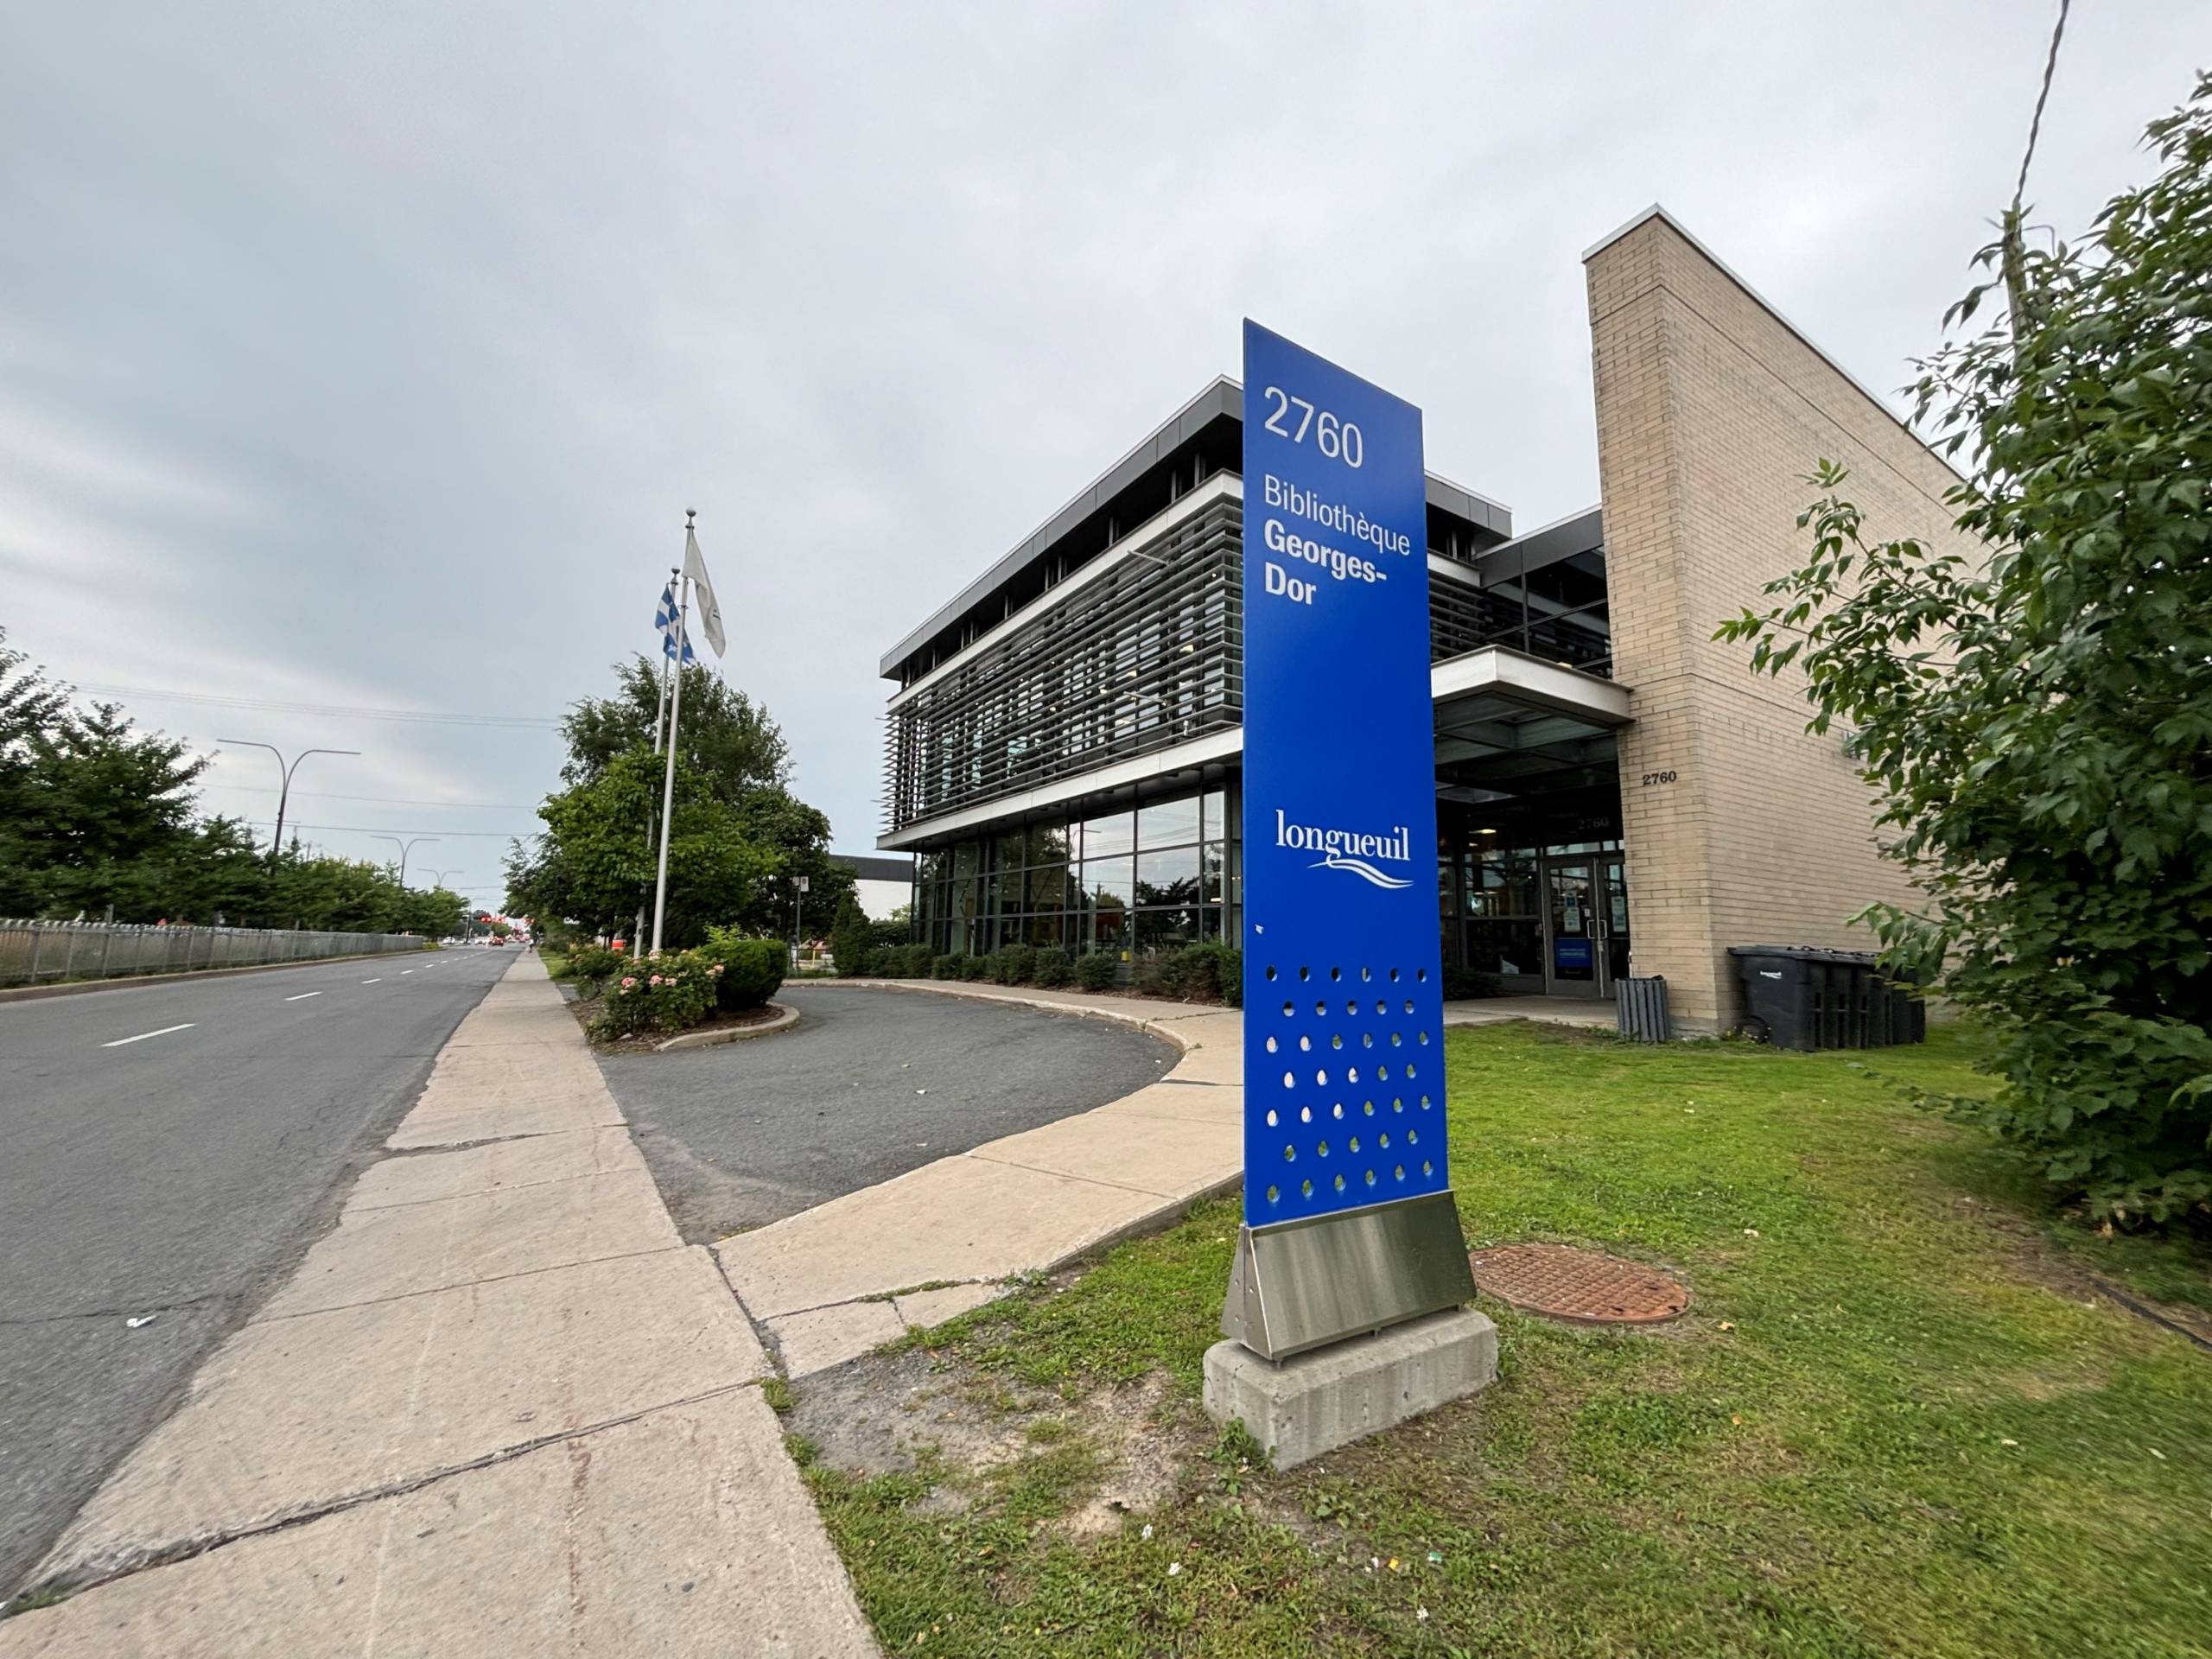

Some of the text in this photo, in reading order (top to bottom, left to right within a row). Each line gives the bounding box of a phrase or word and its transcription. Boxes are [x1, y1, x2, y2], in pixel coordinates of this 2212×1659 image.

[1264, 386, 1363, 468] 2760
[1265, 474, 1410, 556] Bibliothèque
[1264, 518, 1387, 583] Georges-
[1265, 562, 1316, 605] Dor
[1643, 770, 1677, 785] 2760
[1275, 809, 1411, 866] longueuil
